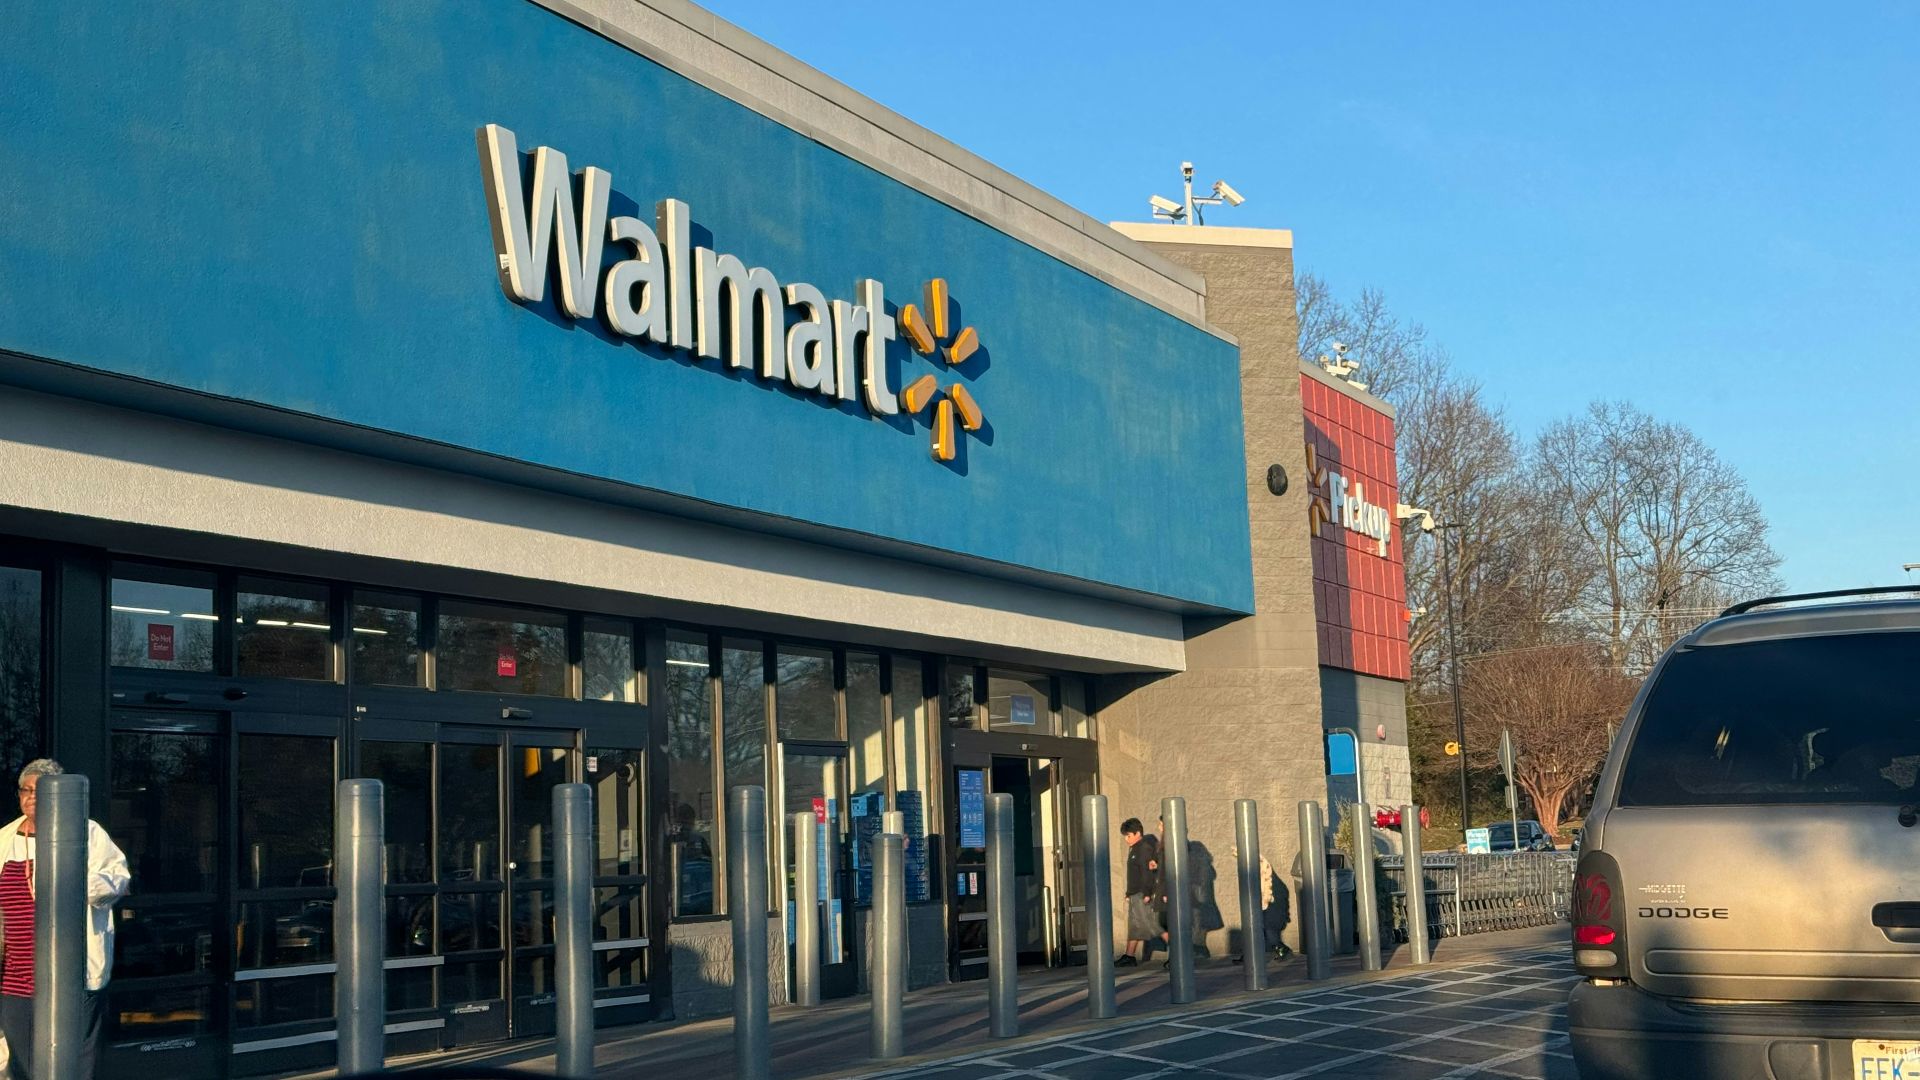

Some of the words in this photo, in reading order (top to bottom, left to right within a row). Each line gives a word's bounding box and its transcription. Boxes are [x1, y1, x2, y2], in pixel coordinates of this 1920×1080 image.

[477, 124, 898, 416] Walmart
[1329, 471, 1391, 557] Pickup
[1638, 907, 1729, 920] DODGE
[1885, 1046, 1908, 1055] First
